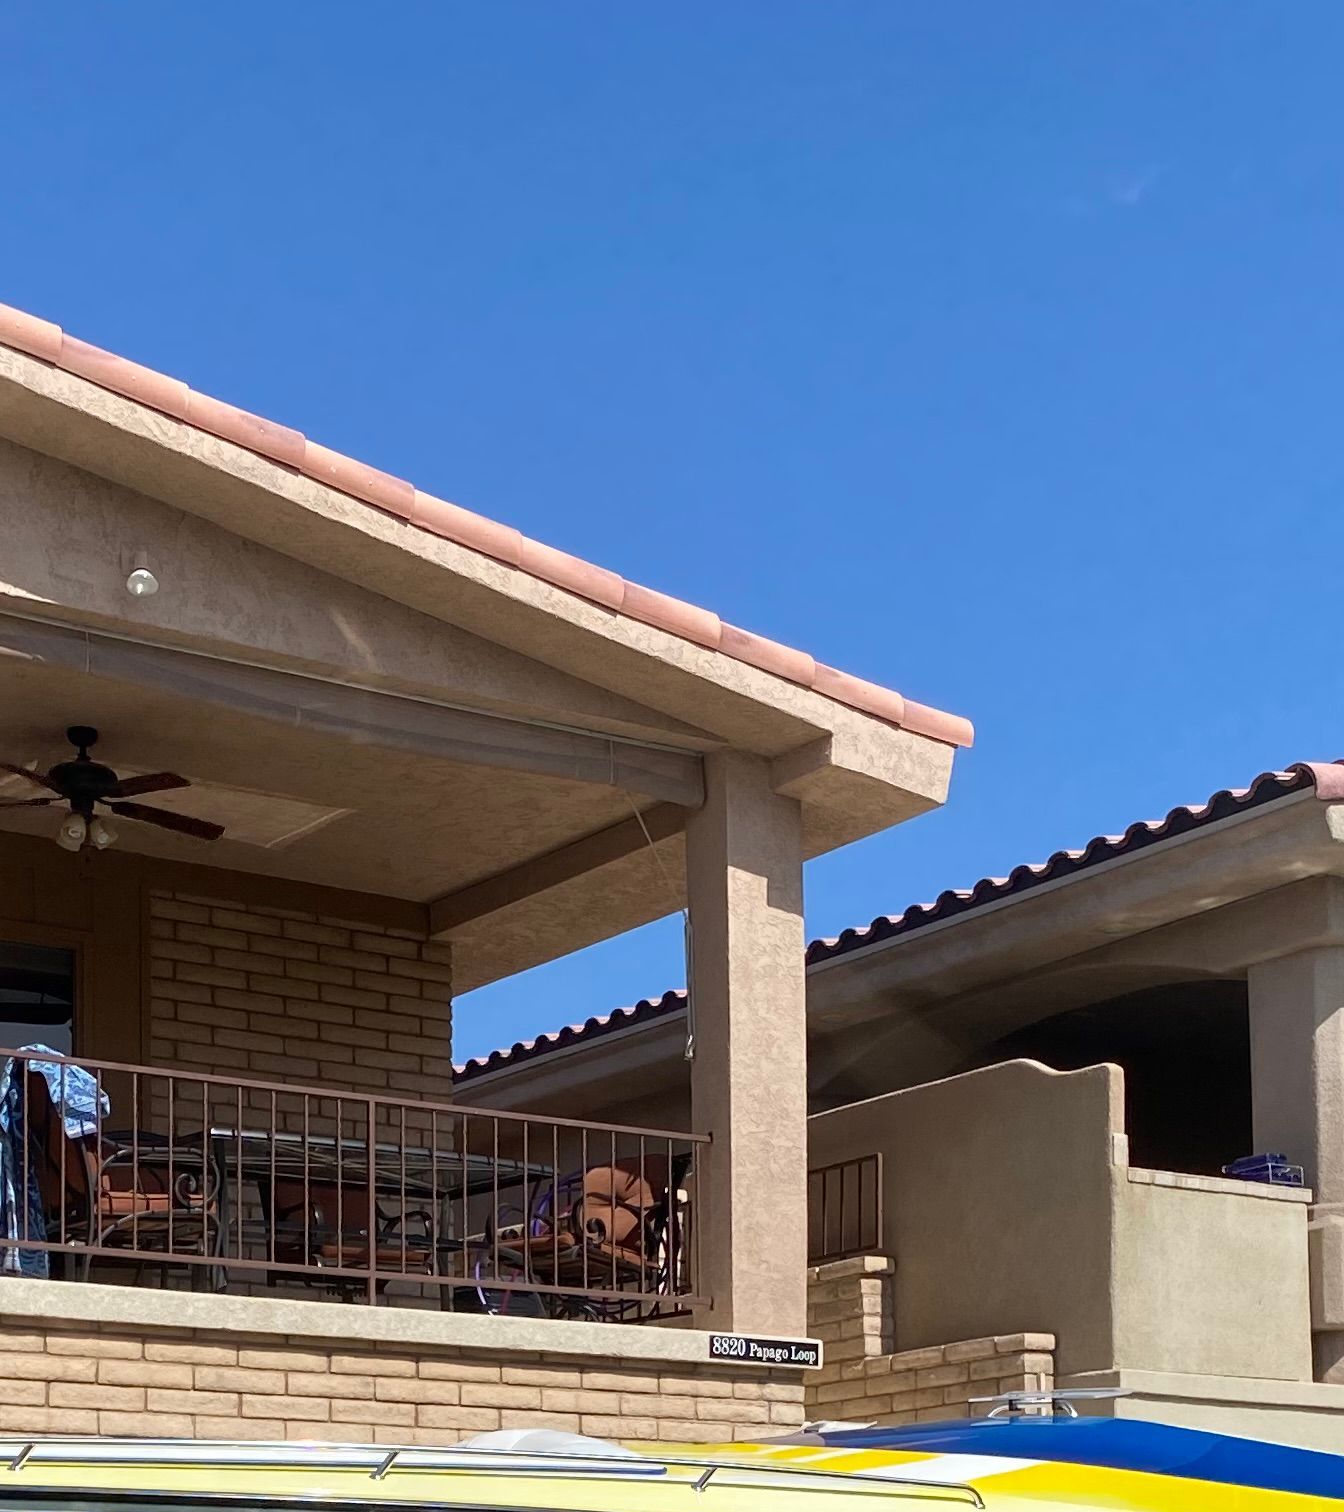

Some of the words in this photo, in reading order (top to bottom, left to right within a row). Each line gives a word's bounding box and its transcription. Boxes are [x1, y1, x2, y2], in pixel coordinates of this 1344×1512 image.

[713, 1336, 746, 1356] 8820
[749, 1342, 788, 1362] Papago
[790, 1346, 816, 1364] Loop
